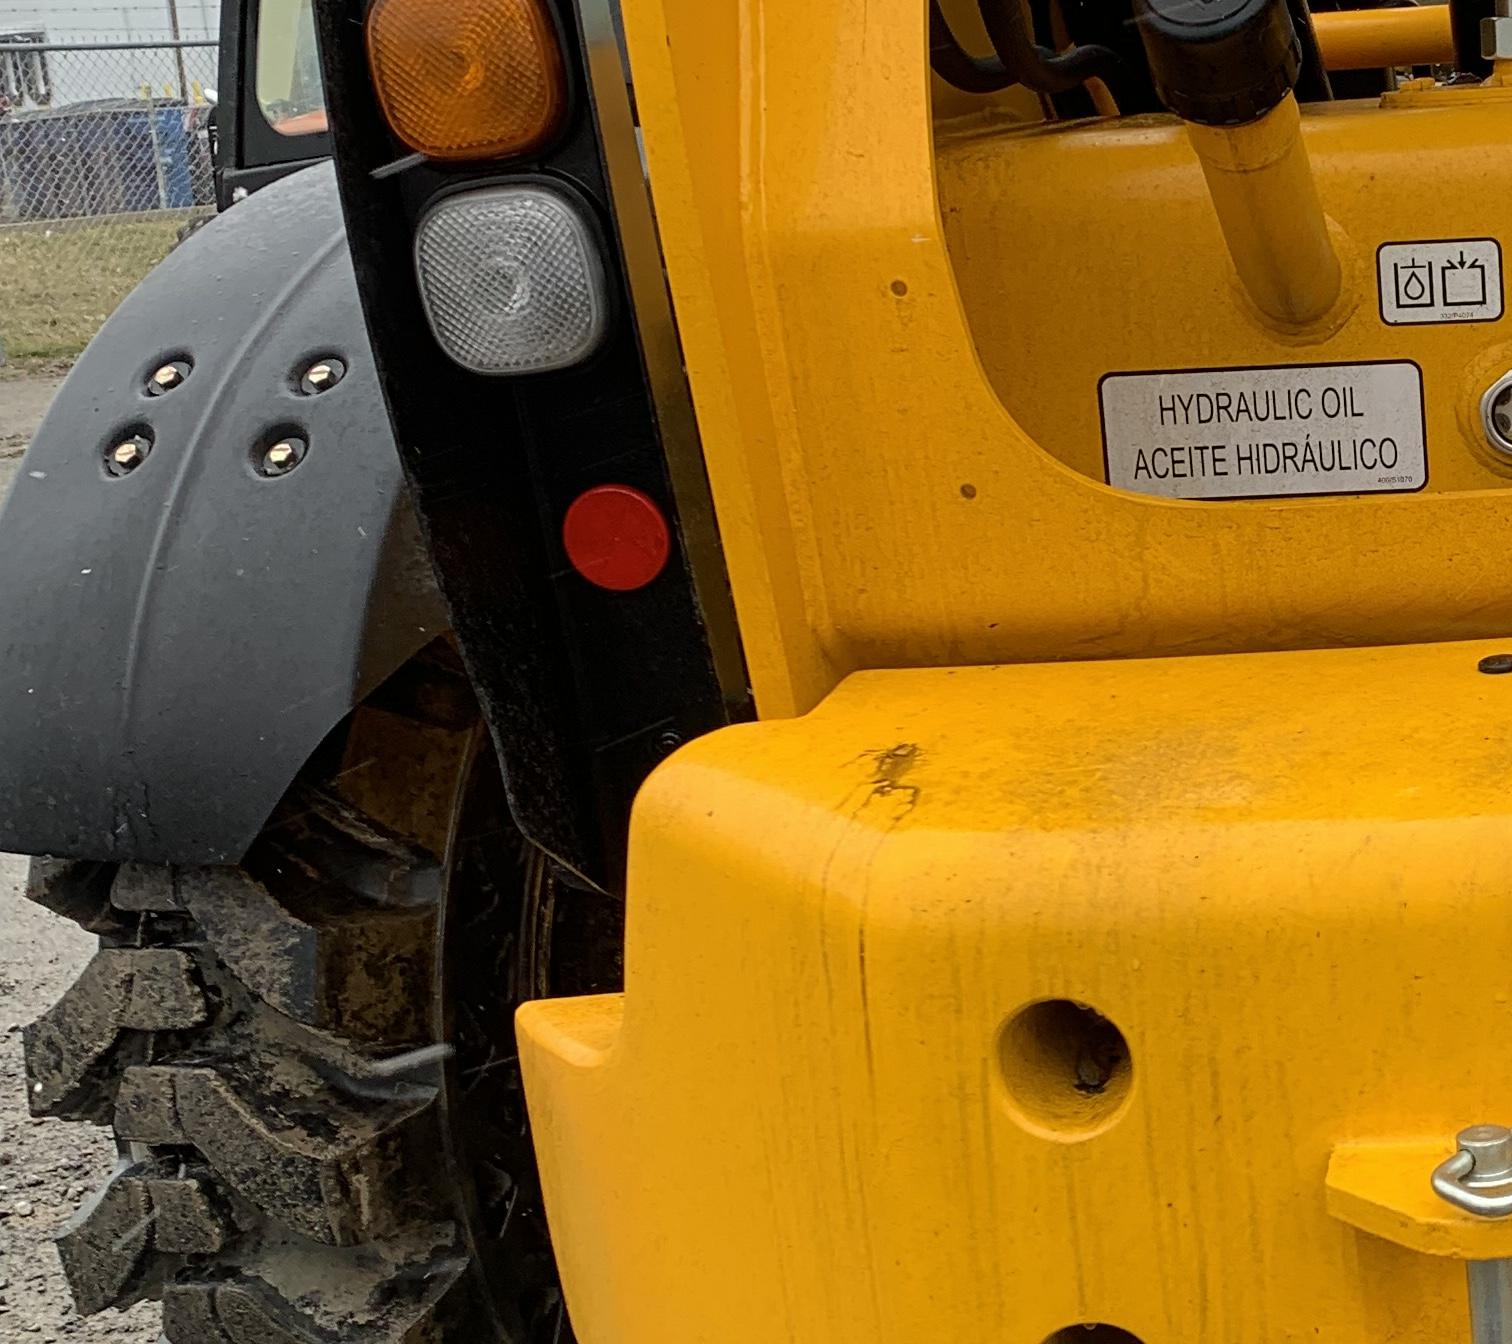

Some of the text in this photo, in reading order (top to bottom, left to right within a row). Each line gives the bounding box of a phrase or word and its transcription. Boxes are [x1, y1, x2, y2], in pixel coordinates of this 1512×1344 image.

[1159, 387, 1363, 425] HYDRAULIC OIL
[1135, 434, 1397, 479] ACEITE HIDRÁULICO
